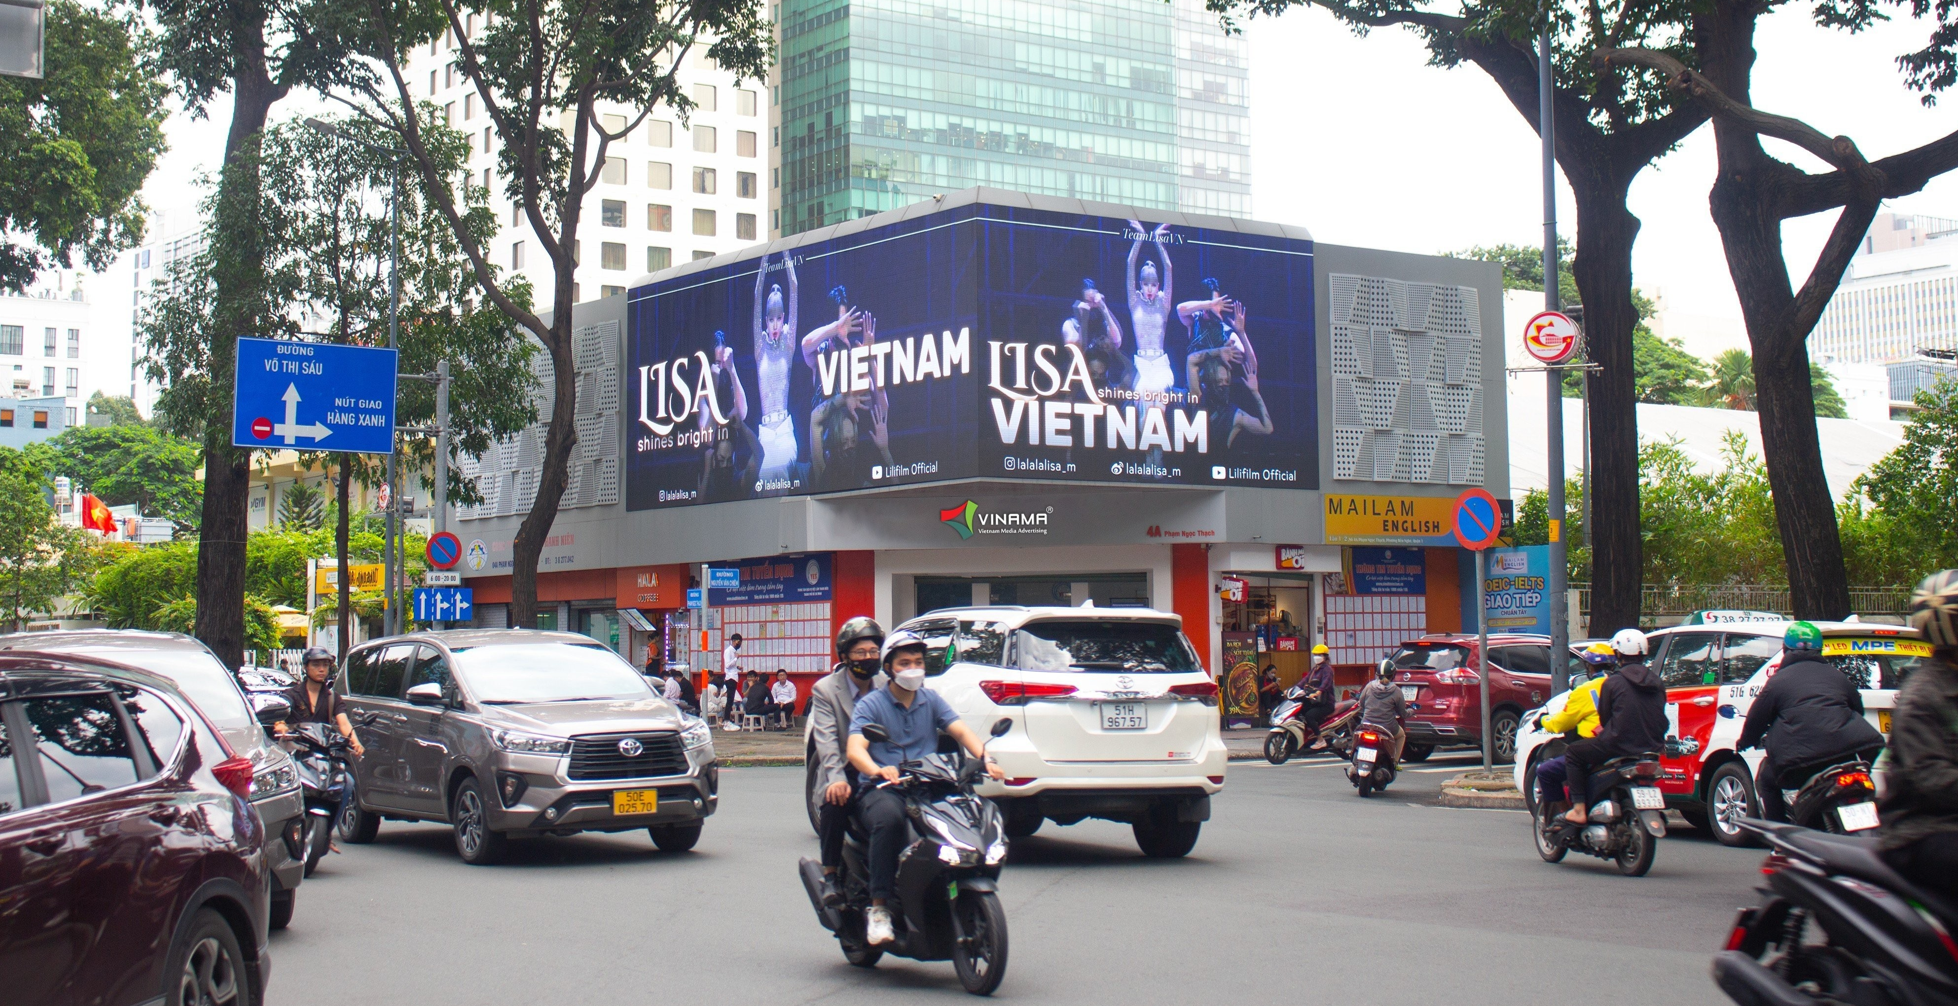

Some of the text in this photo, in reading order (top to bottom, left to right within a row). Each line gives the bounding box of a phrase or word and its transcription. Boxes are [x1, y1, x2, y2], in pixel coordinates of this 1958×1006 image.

[1122, 228, 1185, 244] TeamLisaVN
[277, 344, 314, 356] ĐƯỜNG
[264, 358, 323, 375] VÕ THỊ SÁU
[817, 327, 970, 396] VIETNAM
[987, 340, 1199, 406] LISA shines bright in
[638, 351, 729, 435] LISA
[335, 396, 382, 409] NÚT GIAO
[327, 409, 386, 427] HÀNG XANH
[990, 398, 1208, 453] VIETNAM
[637, 426, 729, 452] shines bright in
[885, 461, 939, 478] Lilifilm Official
[1017, 458, 1077, 473] lalalalisa_m
[1126, 462, 1181, 477] lalalalisa_m
[1228, 467, 1297, 482] Lilifilm Official
[764, 479, 800, 491] lalalalisa_m
[1329, 498, 1414, 516] MAILAM
[978, 513, 1048, 526] VINAMA
[1382, 519, 1440, 533] ENGLISH
[1146, 525, 1162, 537] 4A
[1164, 530, 1181, 538] Phạm
[1484, 576, 1545, 592] OEIC-IELTS
[1485, 590, 1541, 609] GIAO TIẾP
[1851, 641, 1896, 651] MPE
[1730, 686, 1744, 698] 51G
[1114, 705, 1135, 716] 51H
[1107, 716, 1142, 728] 967.57
[626, 791, 645, 802] 50E
[618, 802, 653, 813] 025.70
